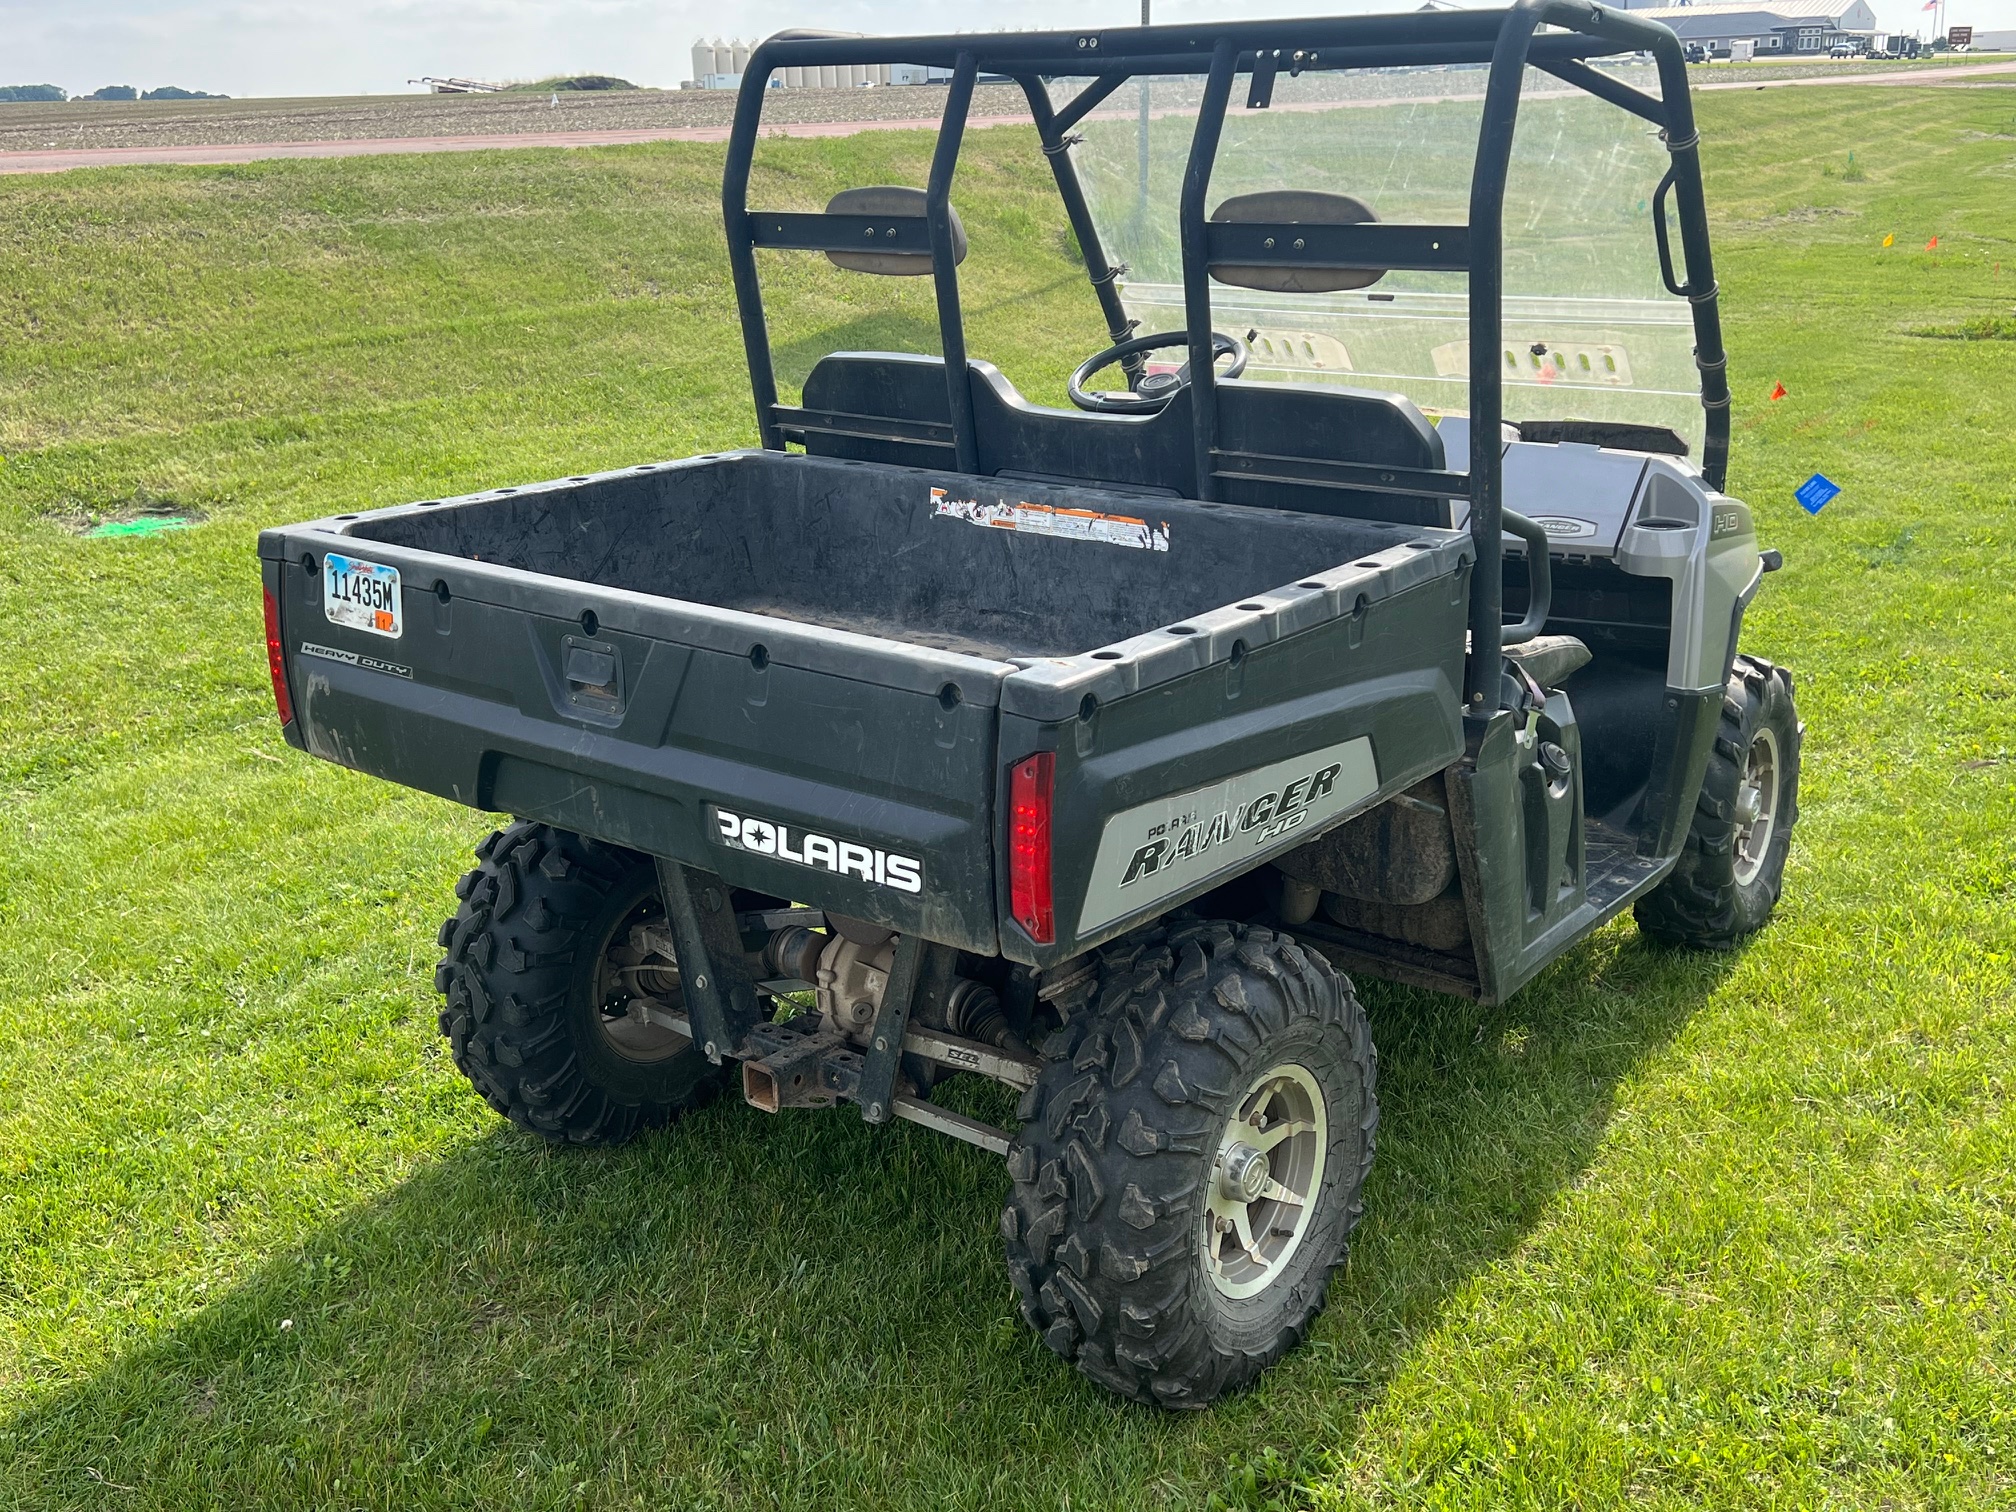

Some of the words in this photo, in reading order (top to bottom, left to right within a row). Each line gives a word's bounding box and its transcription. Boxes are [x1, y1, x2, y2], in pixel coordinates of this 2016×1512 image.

[1714, 513, 1739, 535] HD
[331, 569, 394, 612] 11435M
[304, 644, 356, 661] HEAVY
[361, 658, 407, 674] DUTY
[1117, 761, 1343, 888] RANGER
[1255, 808, 1309, 846] HD
[717, 810, 922, 894] POLARIS
